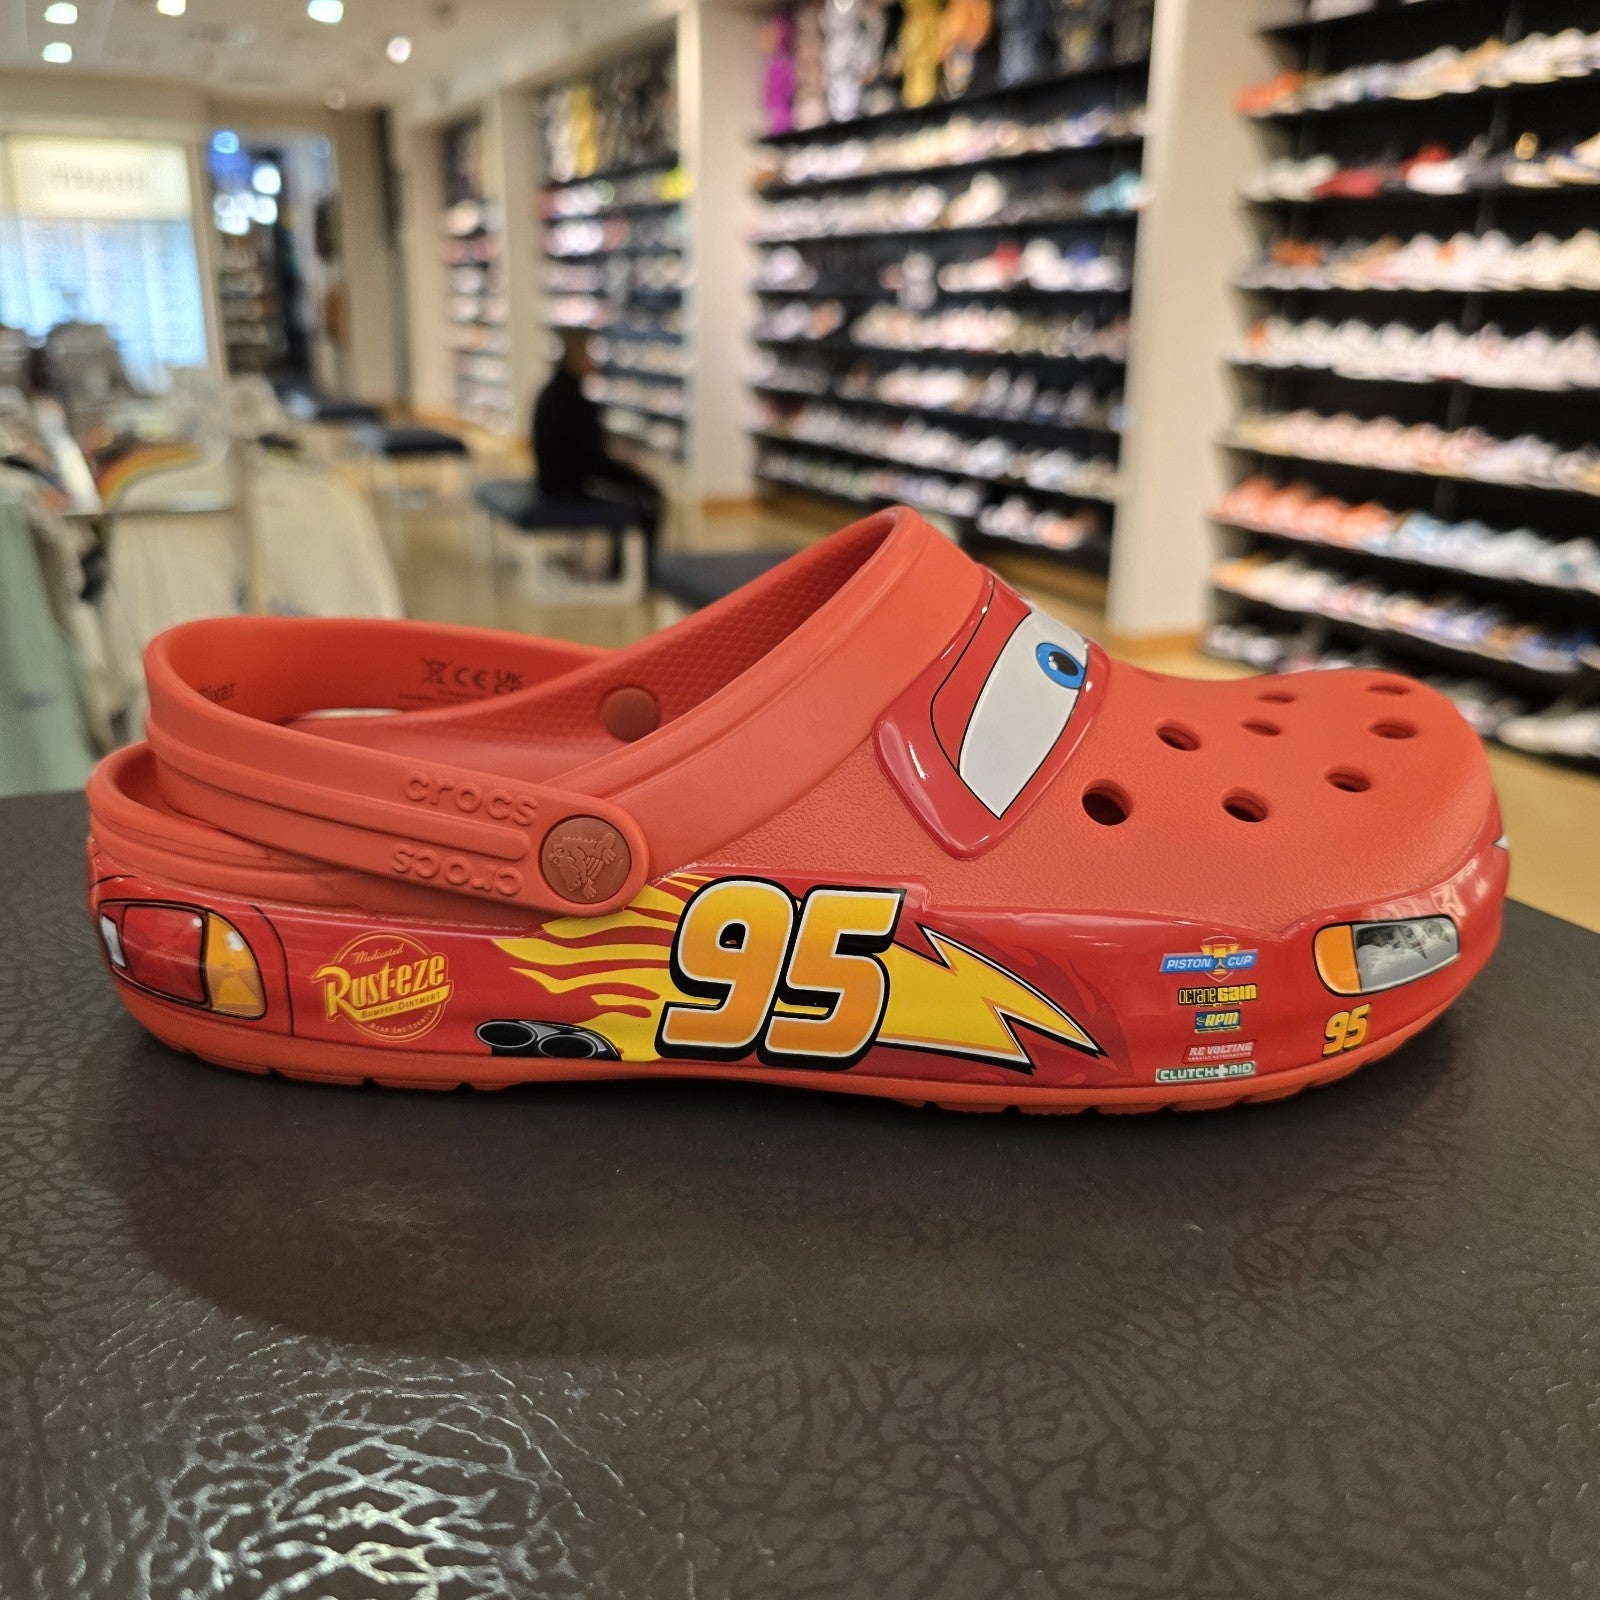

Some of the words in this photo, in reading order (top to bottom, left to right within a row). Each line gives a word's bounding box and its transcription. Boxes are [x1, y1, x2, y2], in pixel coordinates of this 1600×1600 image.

[404, 773, 537, 826] crocs
[392, 844, 523, 896] crocs
[351, 943, 404, 964] Medicated
[656, 877, 906, 1064] 95
[1167, 957, 1211, 969] PISTON
[1227, 954, 1253, 966] CUP
[1205, 1011, 1240, 1027] RPM
[1322, 1003, 1370, 1056] 95
[1160, 1067, 1214, 1080] CLUTCH
